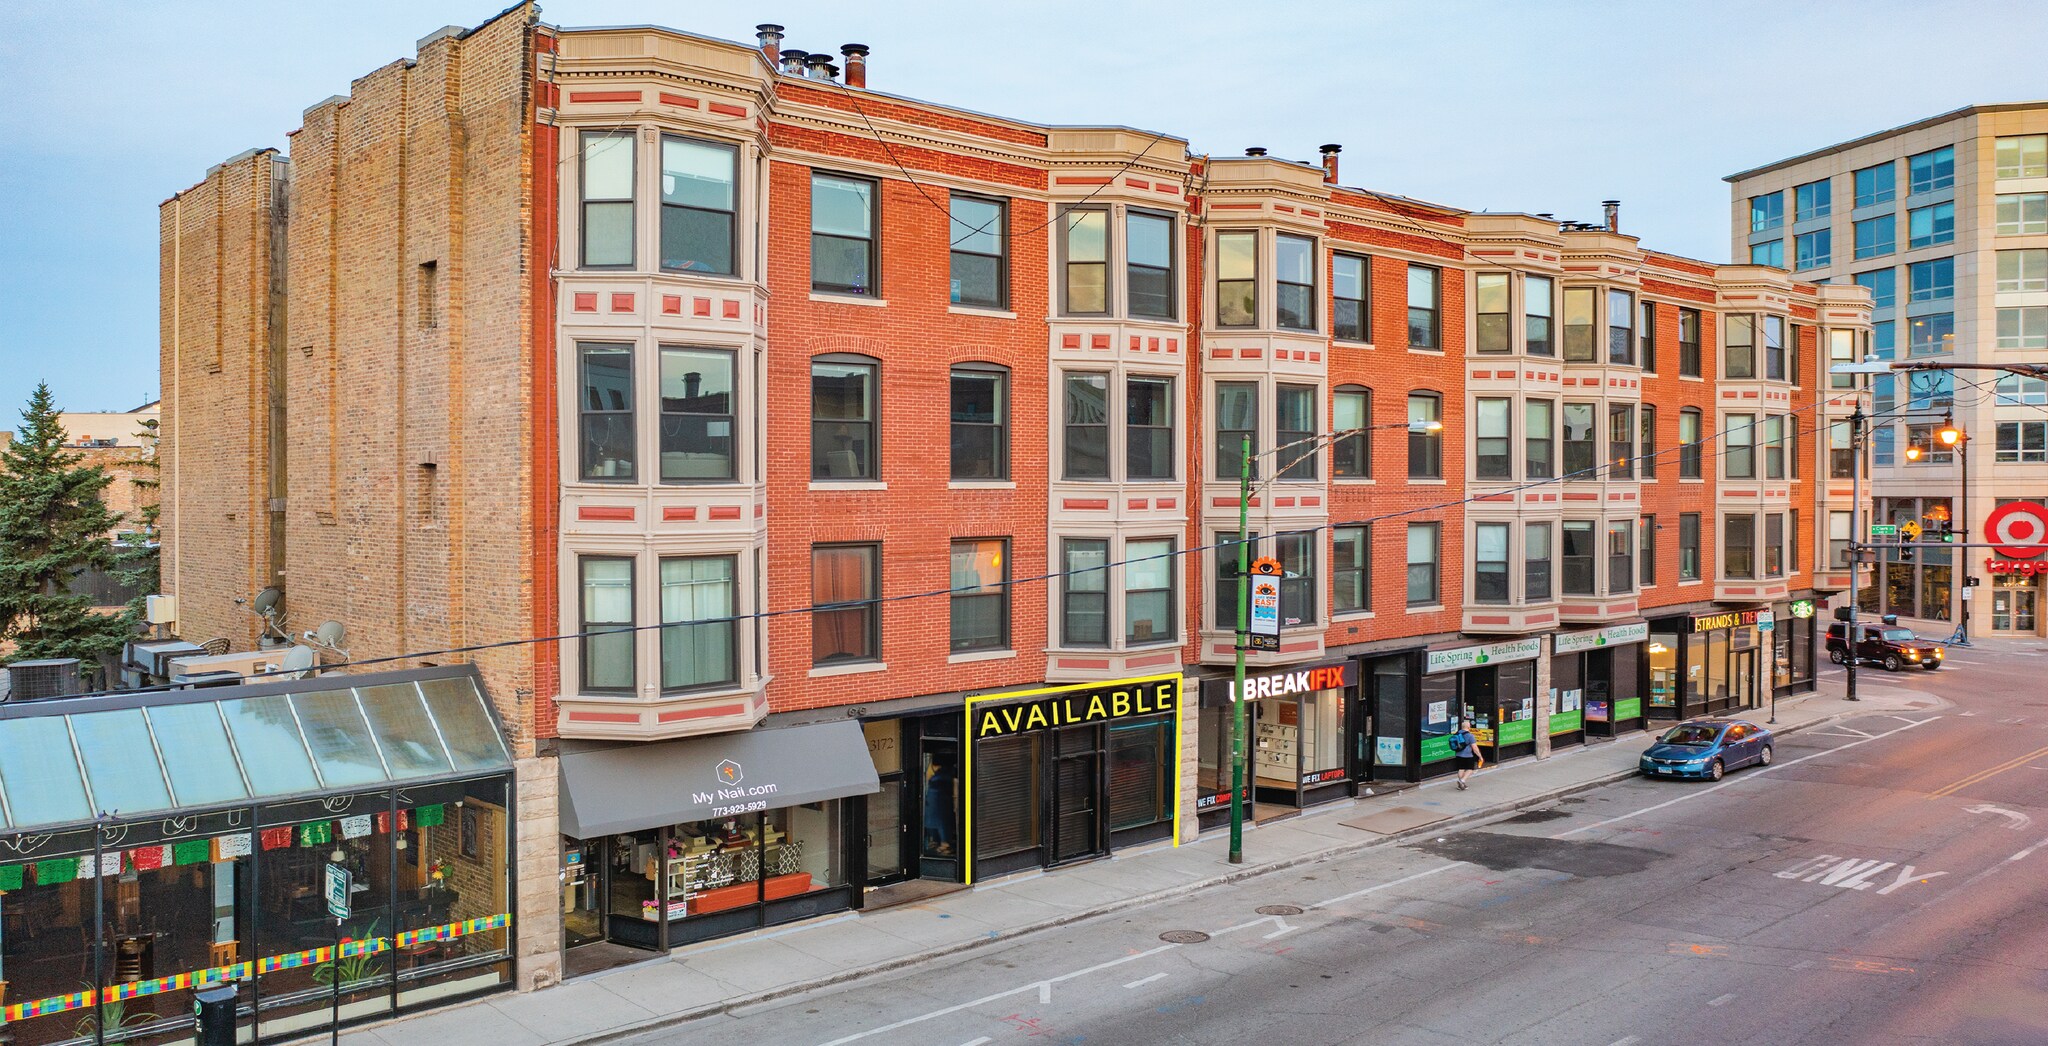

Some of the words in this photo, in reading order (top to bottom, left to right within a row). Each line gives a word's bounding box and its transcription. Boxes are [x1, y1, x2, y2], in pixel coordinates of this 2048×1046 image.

[1985, 557, 2048, 577] targe
[1696, 613, 1733, 632] STRANDS
[1734, 612, 1740, 626] &
[1558, 635, 1571, 646] Life
[1572, 633, 1593, 645] Spring
[1607, 628, 1628, 639] Health
[1628, 625, 1646, 636] Foods
[1430, 653, 1446, 665] Life
[1446, 650, 1473, 664] Spring
[1491, 643, 1516, 656] Health
[1517, 640, 1539, 652] Foods
[869, 737, 894, 752] 3172
[1302, 775, 1311, 784] WE
[1311, 773, 1321, 783] FIX
[1321, 768, 1345, 781] LAPTOPS
[692, 791, 714, 805] My
[717, 783, 778, 800] Nail.com
[1197, 797, 1207, 808] WE
[1206, 795, 1216, 805] FIX
[712, 800, 767, 817] 773-929-5929
[1772, 854, 1950, 895] ONLY
